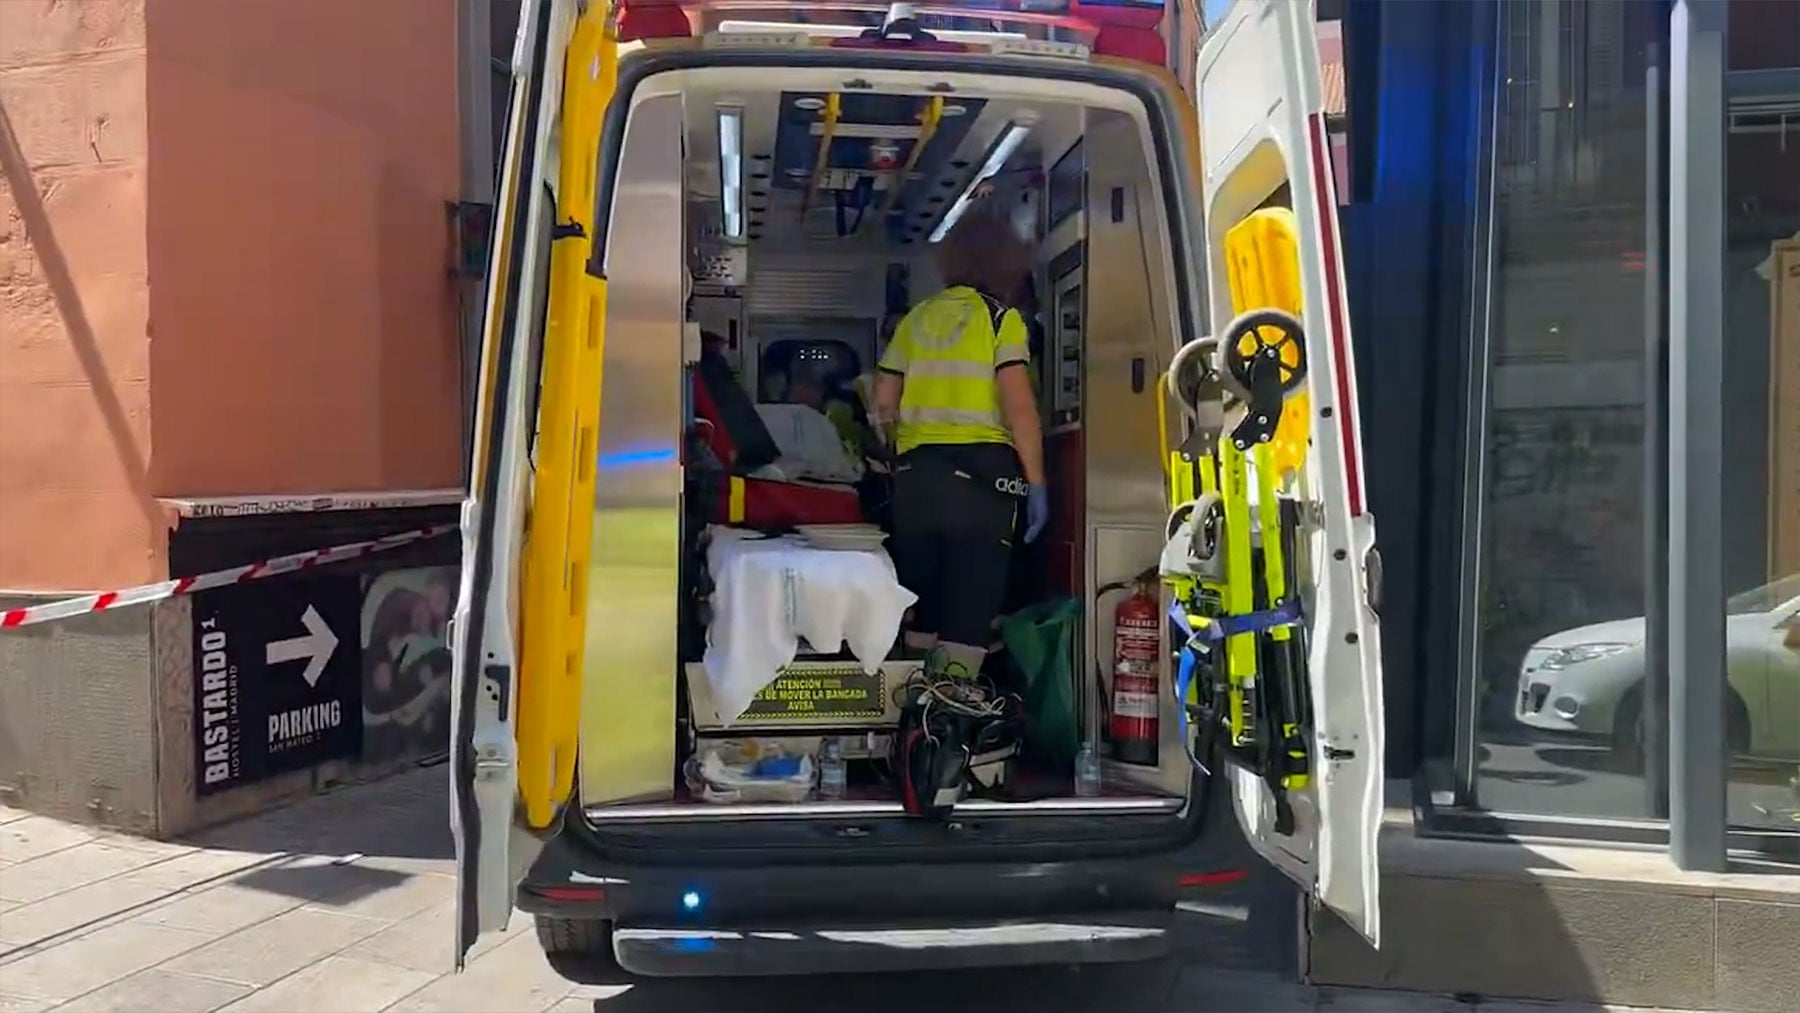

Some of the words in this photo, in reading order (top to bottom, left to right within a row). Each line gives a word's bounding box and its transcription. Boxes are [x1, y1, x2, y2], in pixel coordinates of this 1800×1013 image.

[779, 690, 811, 700] MOVER
[812, 690, 824, 700] LA
[825, 689, 868, 699] BANCADA
[268, 699, 341, 743] PARKING
